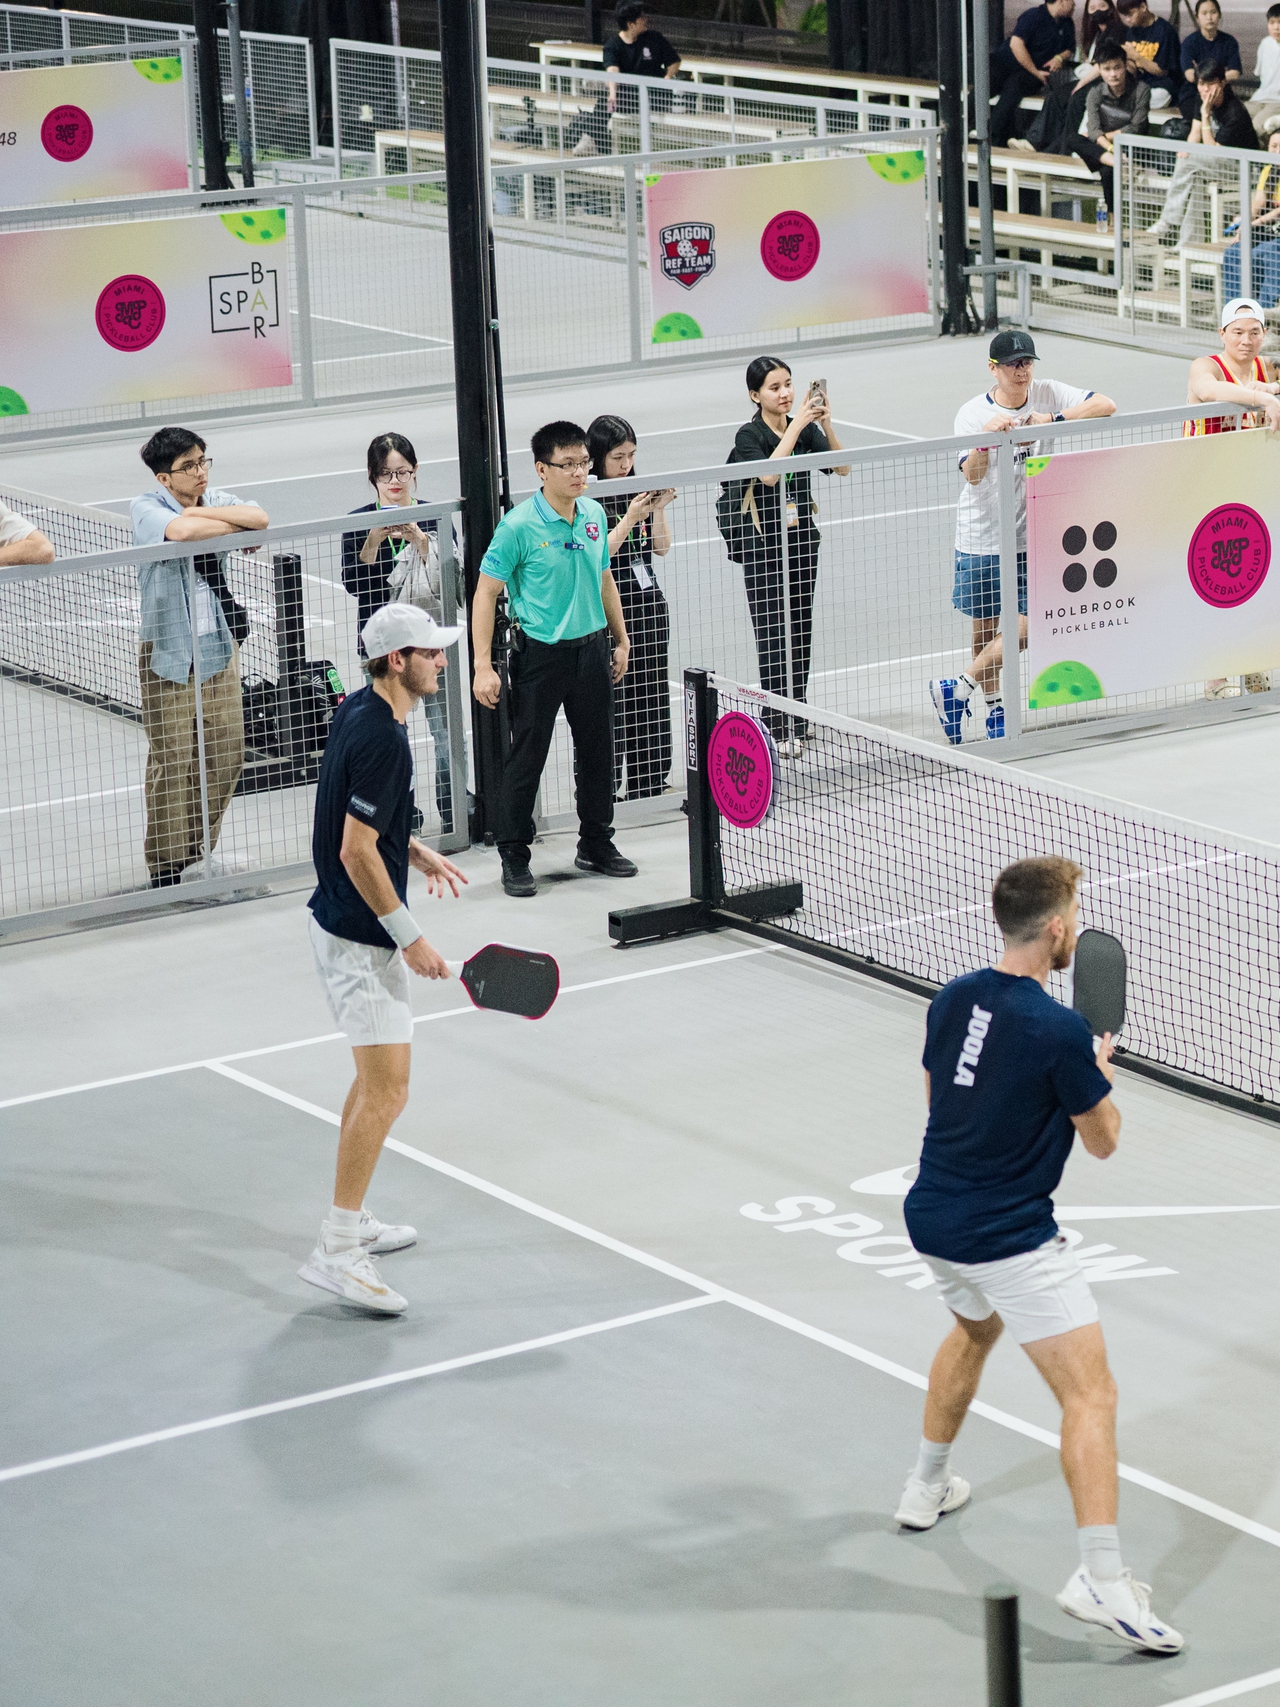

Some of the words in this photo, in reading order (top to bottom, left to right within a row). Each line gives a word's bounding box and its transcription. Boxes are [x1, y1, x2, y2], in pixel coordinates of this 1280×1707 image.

[664, 226, 710, 244] SAIGON
[777, 219, 803, 231] MIAMI
[665, 258, 682, 270] REF
[685, 255, 712, 267] TEAM
[769, 245, 803, 273] PICKLEBALL
[803, 241, 813, 263] CLUB
[114, 284, 146, 296] MIAMI
[104, 312, 146, 343] PICKLEBALL
[145, 308, 158, 333] CLUB
[1210, 516, 1248, 535] MIAMI
[1198, 556, 1247, 596] PICKLEBALL
[1246, 547, 1262, 581] CLUB
[1045, 596, 1136, 620] HOLBROOK
[1052, 616, 1129, 636] PICKLEBALL
[729, 726, 757, 751] MIAMI
[716, 753, 749, 814] PICKLEBALL
[749, 778, 764, 810] CLUB
[953, 1004, 993, 1087] JOOLA
